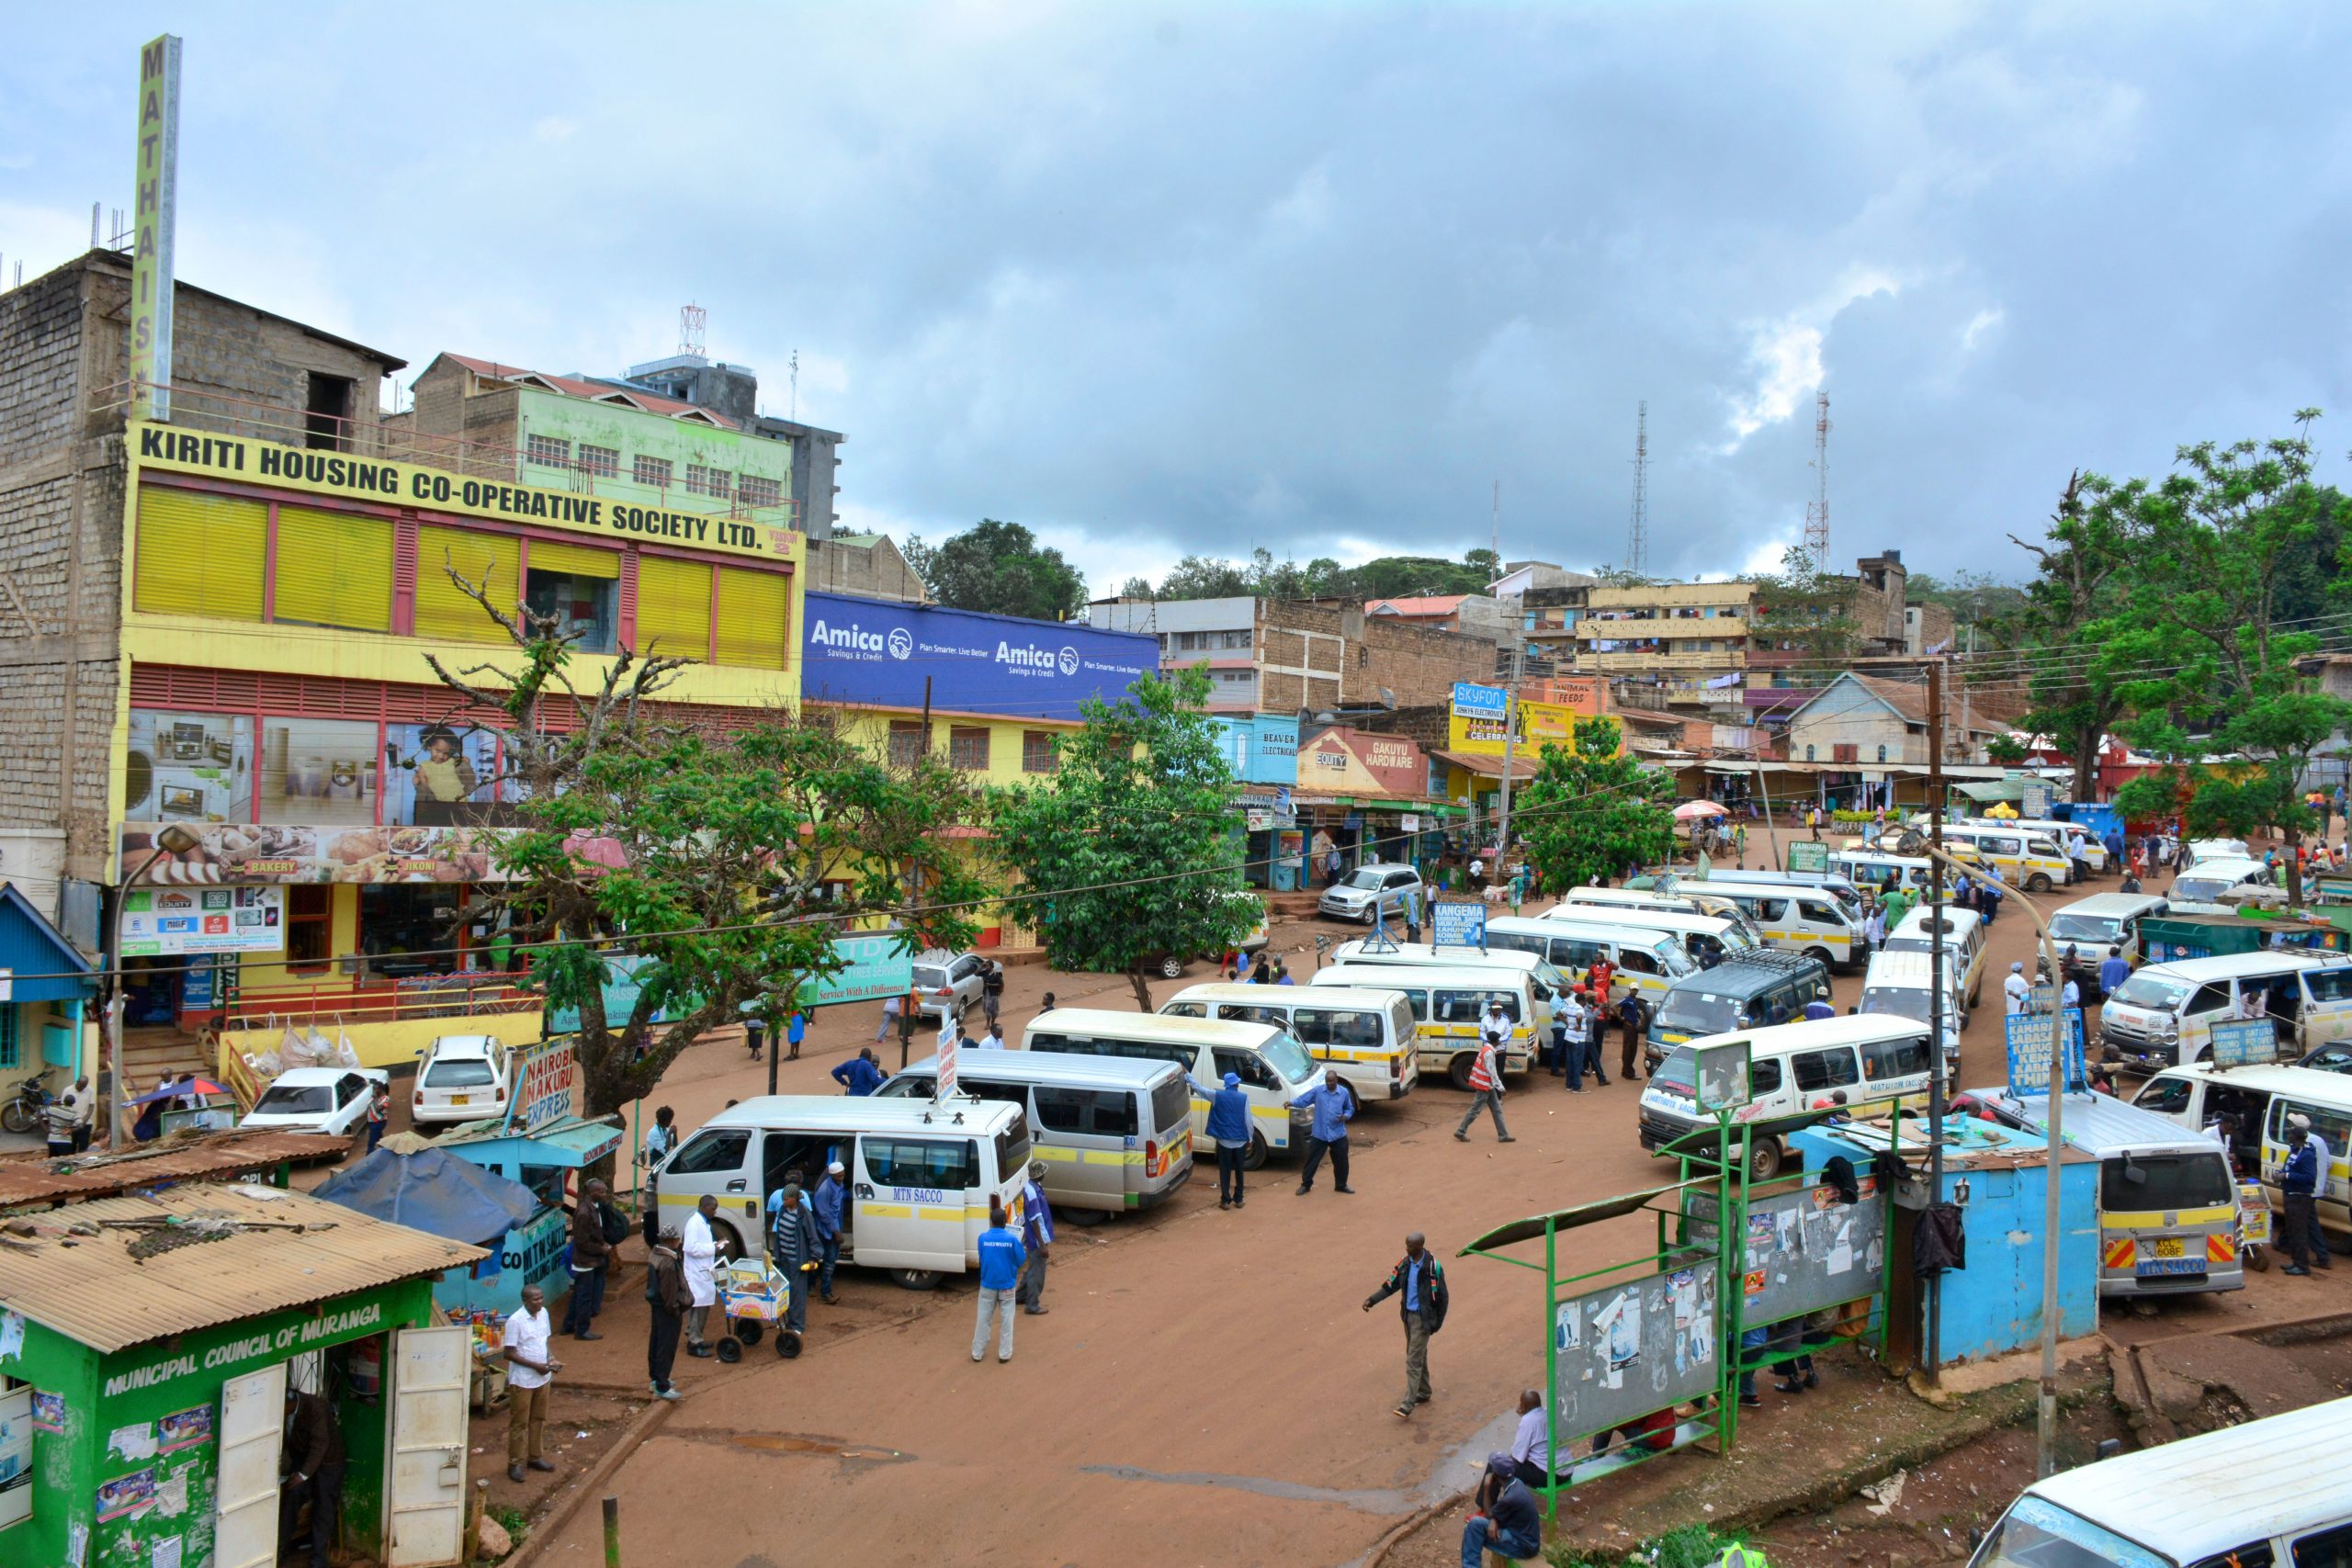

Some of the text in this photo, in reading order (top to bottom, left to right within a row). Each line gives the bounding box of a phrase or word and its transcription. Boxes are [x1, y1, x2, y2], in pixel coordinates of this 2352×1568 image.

[135, 42, 164, 351] MATHAIS
[141, 428, 763, 550] KIRITI HOUSING CO-OPERATIVE SOCIETY LTD.
[768, 529, 798, 545] VISION
[811, 619, 884, 652] Amica
[827, 649, 854, 660] Savings
[863, 652, 883, 662] Credit
[920, 643, 989, 658] Plan Smarter. Live Better
[995, 640, 1055, 668] Amica
[1009, 666, 1031, 677] Savings
[1037, 669, 1055, 679] Credit
[1084, 660, 1094, 670] Plan
[1116, 664, 1125, 673] Live
[1126, 665, 1141, 675] Better
[1558, 694, 1585, 704] FEEDS
[1474, 707, 1504, 718] ELECTRONICS
[1263, 733, 1295, 744] BEAVER
[1373, 742, 1408, 755] GAKUYU
[1316, 753, 1346, 767] EQUITY
[1366, 754, 1413, 769] HARDWARE
[251, 861, 296, 874] BAKERY
[403, 860, 435, 873] JIKONI
[1435, 905, 1484, 917] KANGEMA
[848, 964, 908, 979] TYRES SERVICES
[819, 984, 905, 999] Service With A Difference
[527, 1048, 573, 1082] NAIROBI
[527, 1066, 572, 1103] NAKURU
[527, 1089, 571, 1128] EXPRESS
[583, 1141, 606, 1164] BOOKING
[893, 1188, 943, 1203] MTN SACCO
[547, 1225, 566, 1256] SACCO
[2155, 1238, 2175, 1248] KCL
[2137, 1258, 2207, 1276] MTN SACCO
[105, 1303, 380, 1398] MUNICIPAL COUNCIL OF MURANGA
